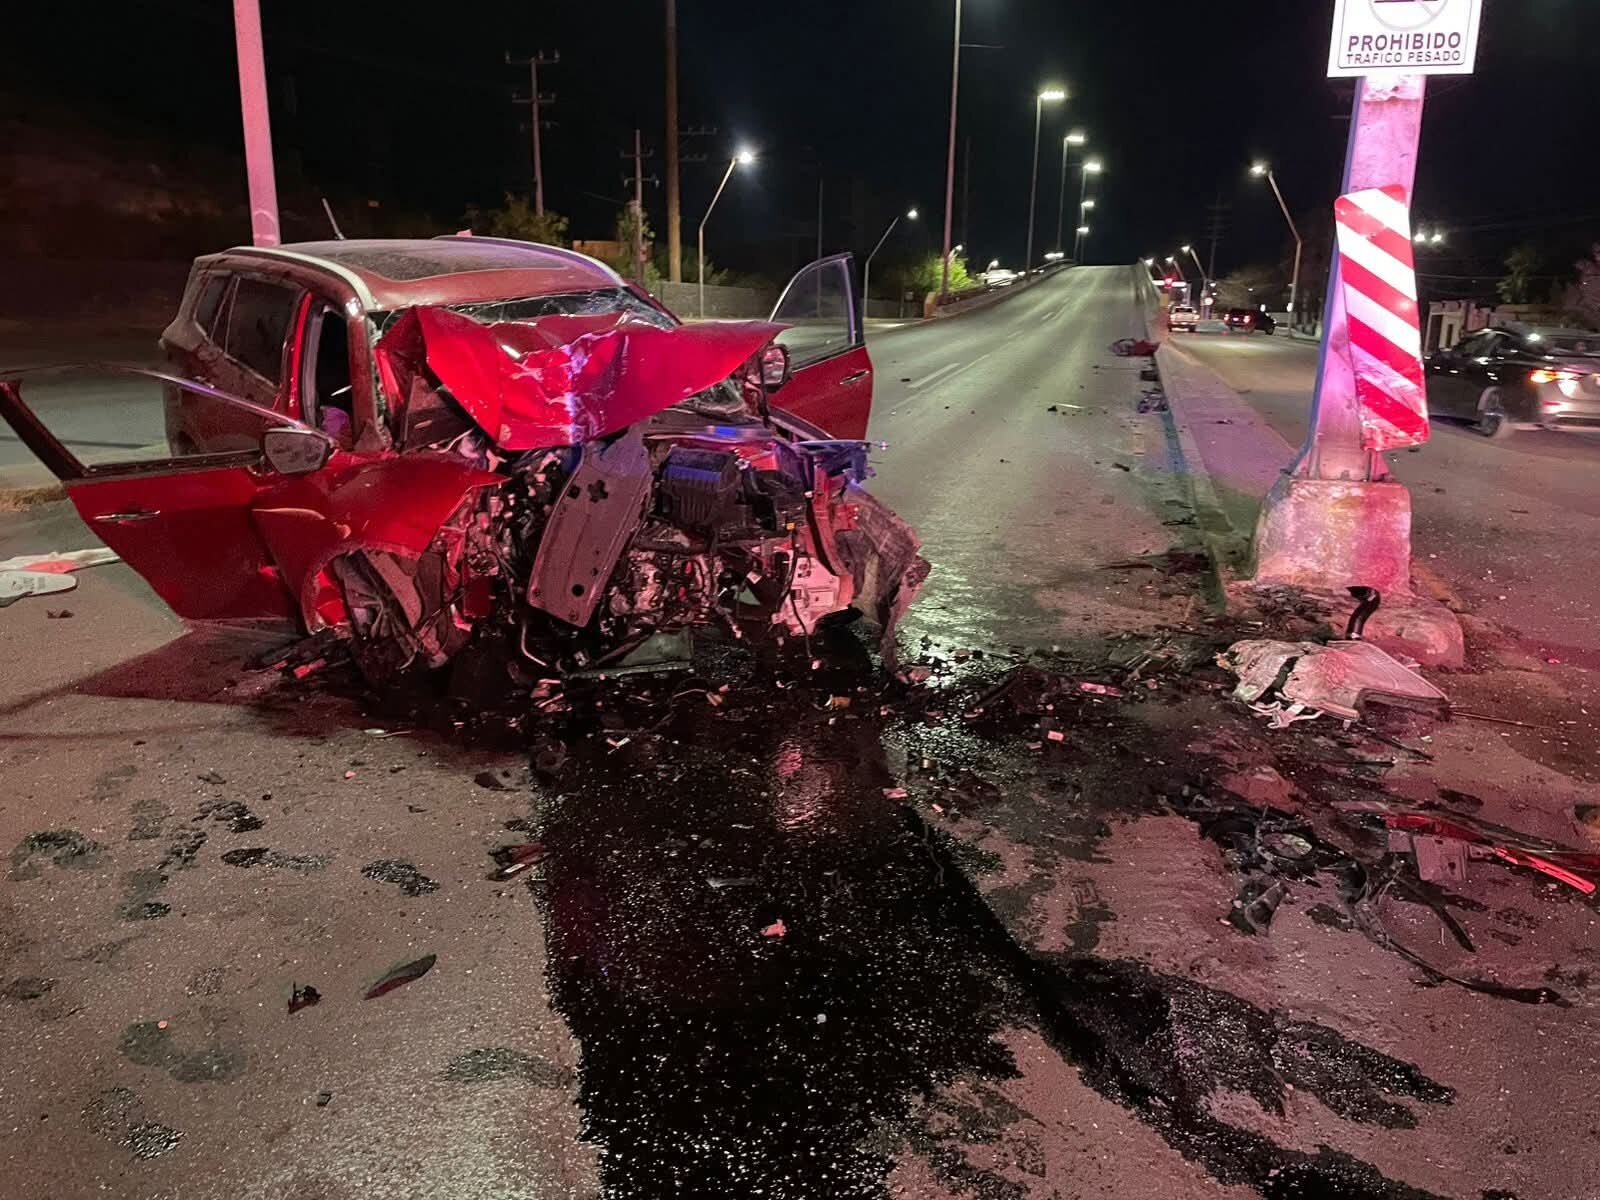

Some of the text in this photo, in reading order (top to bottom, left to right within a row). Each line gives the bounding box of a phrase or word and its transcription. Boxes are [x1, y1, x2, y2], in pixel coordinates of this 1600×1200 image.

[1348, 32, 1461, 52] PROHIBIDO
[1346, 50, 1461, 64] TRAFICO PESADO
